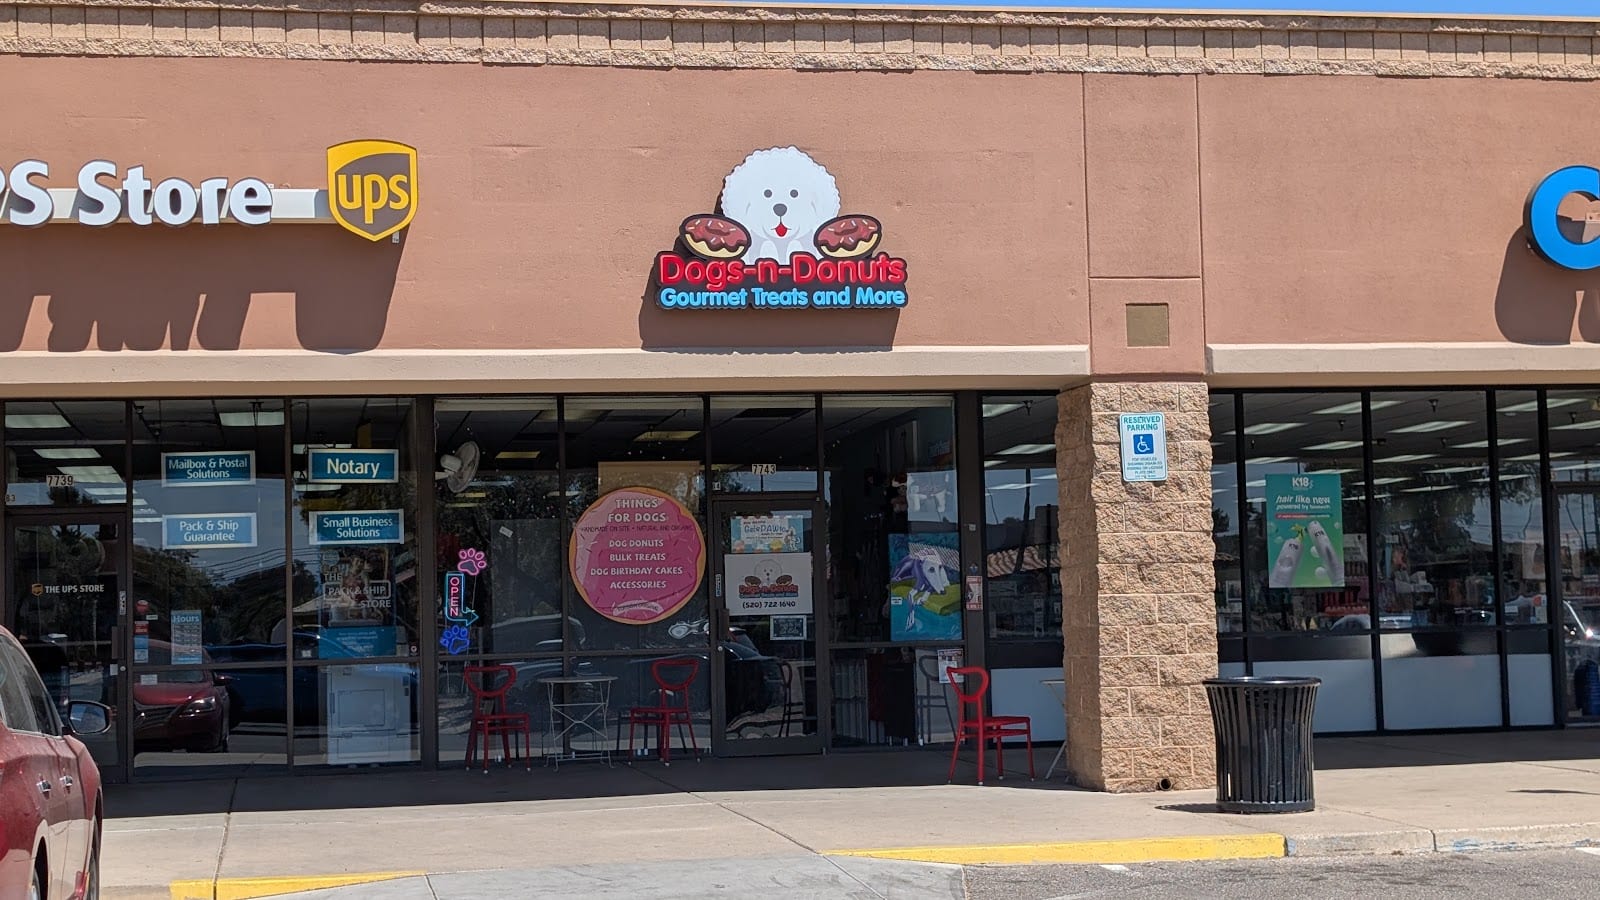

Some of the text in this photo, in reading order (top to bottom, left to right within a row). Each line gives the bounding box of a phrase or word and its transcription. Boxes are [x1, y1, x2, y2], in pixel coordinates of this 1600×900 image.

[77, 159, 273, 226] Store
[337, 173, 409, 224] ups
[659, 253, 905, 291] Dogs-n-Donuts
[660, 286, 906, 306] Gourmet Treats and More
[1124, 416, 1160, 424] RESERVED
[168, 457, 248, 470] Mailbox & Postal
[326, 457, 380, 478] Notary
[186, 469, 230, 479] Solutions
[752, 464, 776, 474] 7743
[47, 475, 74, 486] 7739
[1292, 476, 1309, 487] K18
[615, 499, 658, 509] THINGS
[1275, 494, 1331, 505] hair like new
[323, 516, 393, 528] Small Business
[608, 512, 667, 522] FOR DOGS
[180, 520, 239, 532] Pack & Ship
[183, 531, 236, 542] Guarantee
[336, 528, 381, 538] Solutions
[609, 539, 664, 548] DOG DONUTS
[609, 552, 666, 561] BULK TREATS
[590, 566, 683, 576] DOG BIRTHDAY CAKES
[324, 573, 343, 582] THE
[45, 584, 105, 594] THE UPS STORE
[610, 581, 667, 589] ACCESSORIES
[364, 586, 386, 595] SHIP
[450, 577, 460, 616] OPEN
[360, 599, 391, 608] STORE
[742, 601, 762, 609] (520)
[173, 614, 200, 623] Hours
